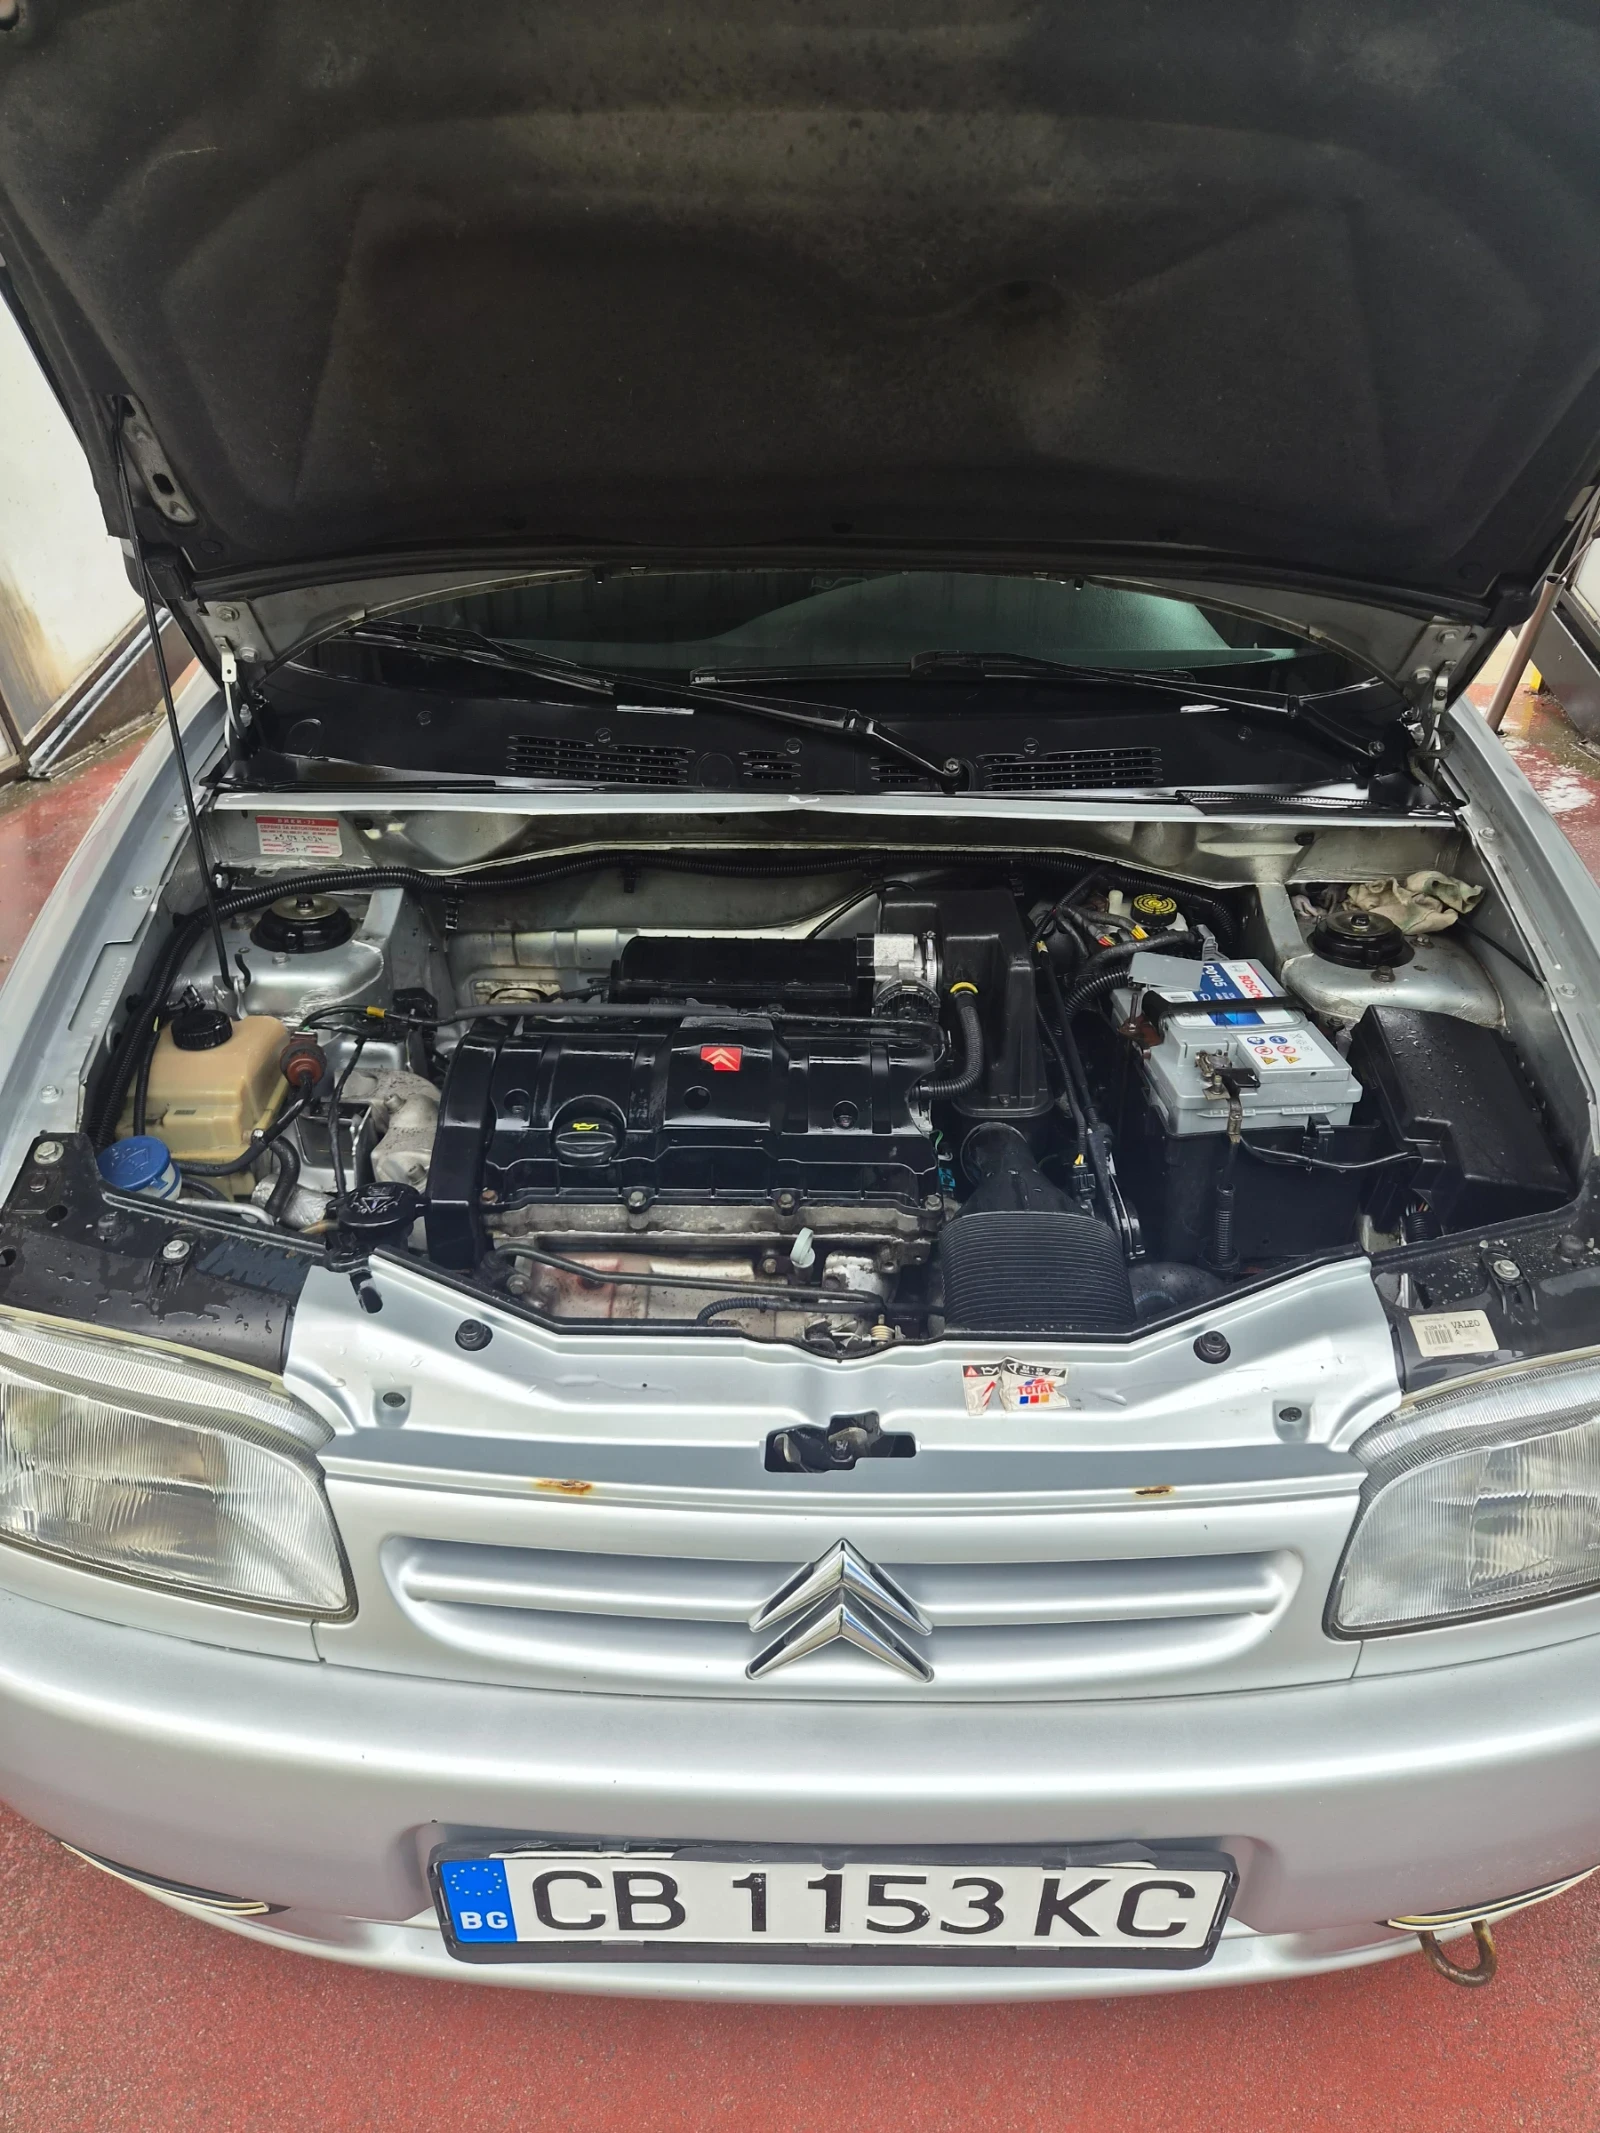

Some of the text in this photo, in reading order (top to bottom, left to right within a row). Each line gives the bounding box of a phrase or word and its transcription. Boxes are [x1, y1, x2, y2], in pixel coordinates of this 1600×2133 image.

[1238, 975, 1263, 999] BOSCH
[1450, 1319, 1480, 1329] VALEO
[532, 1870, 1196, 1938] CB 1153 KC
[459, 1911, 508, 1929] BG
